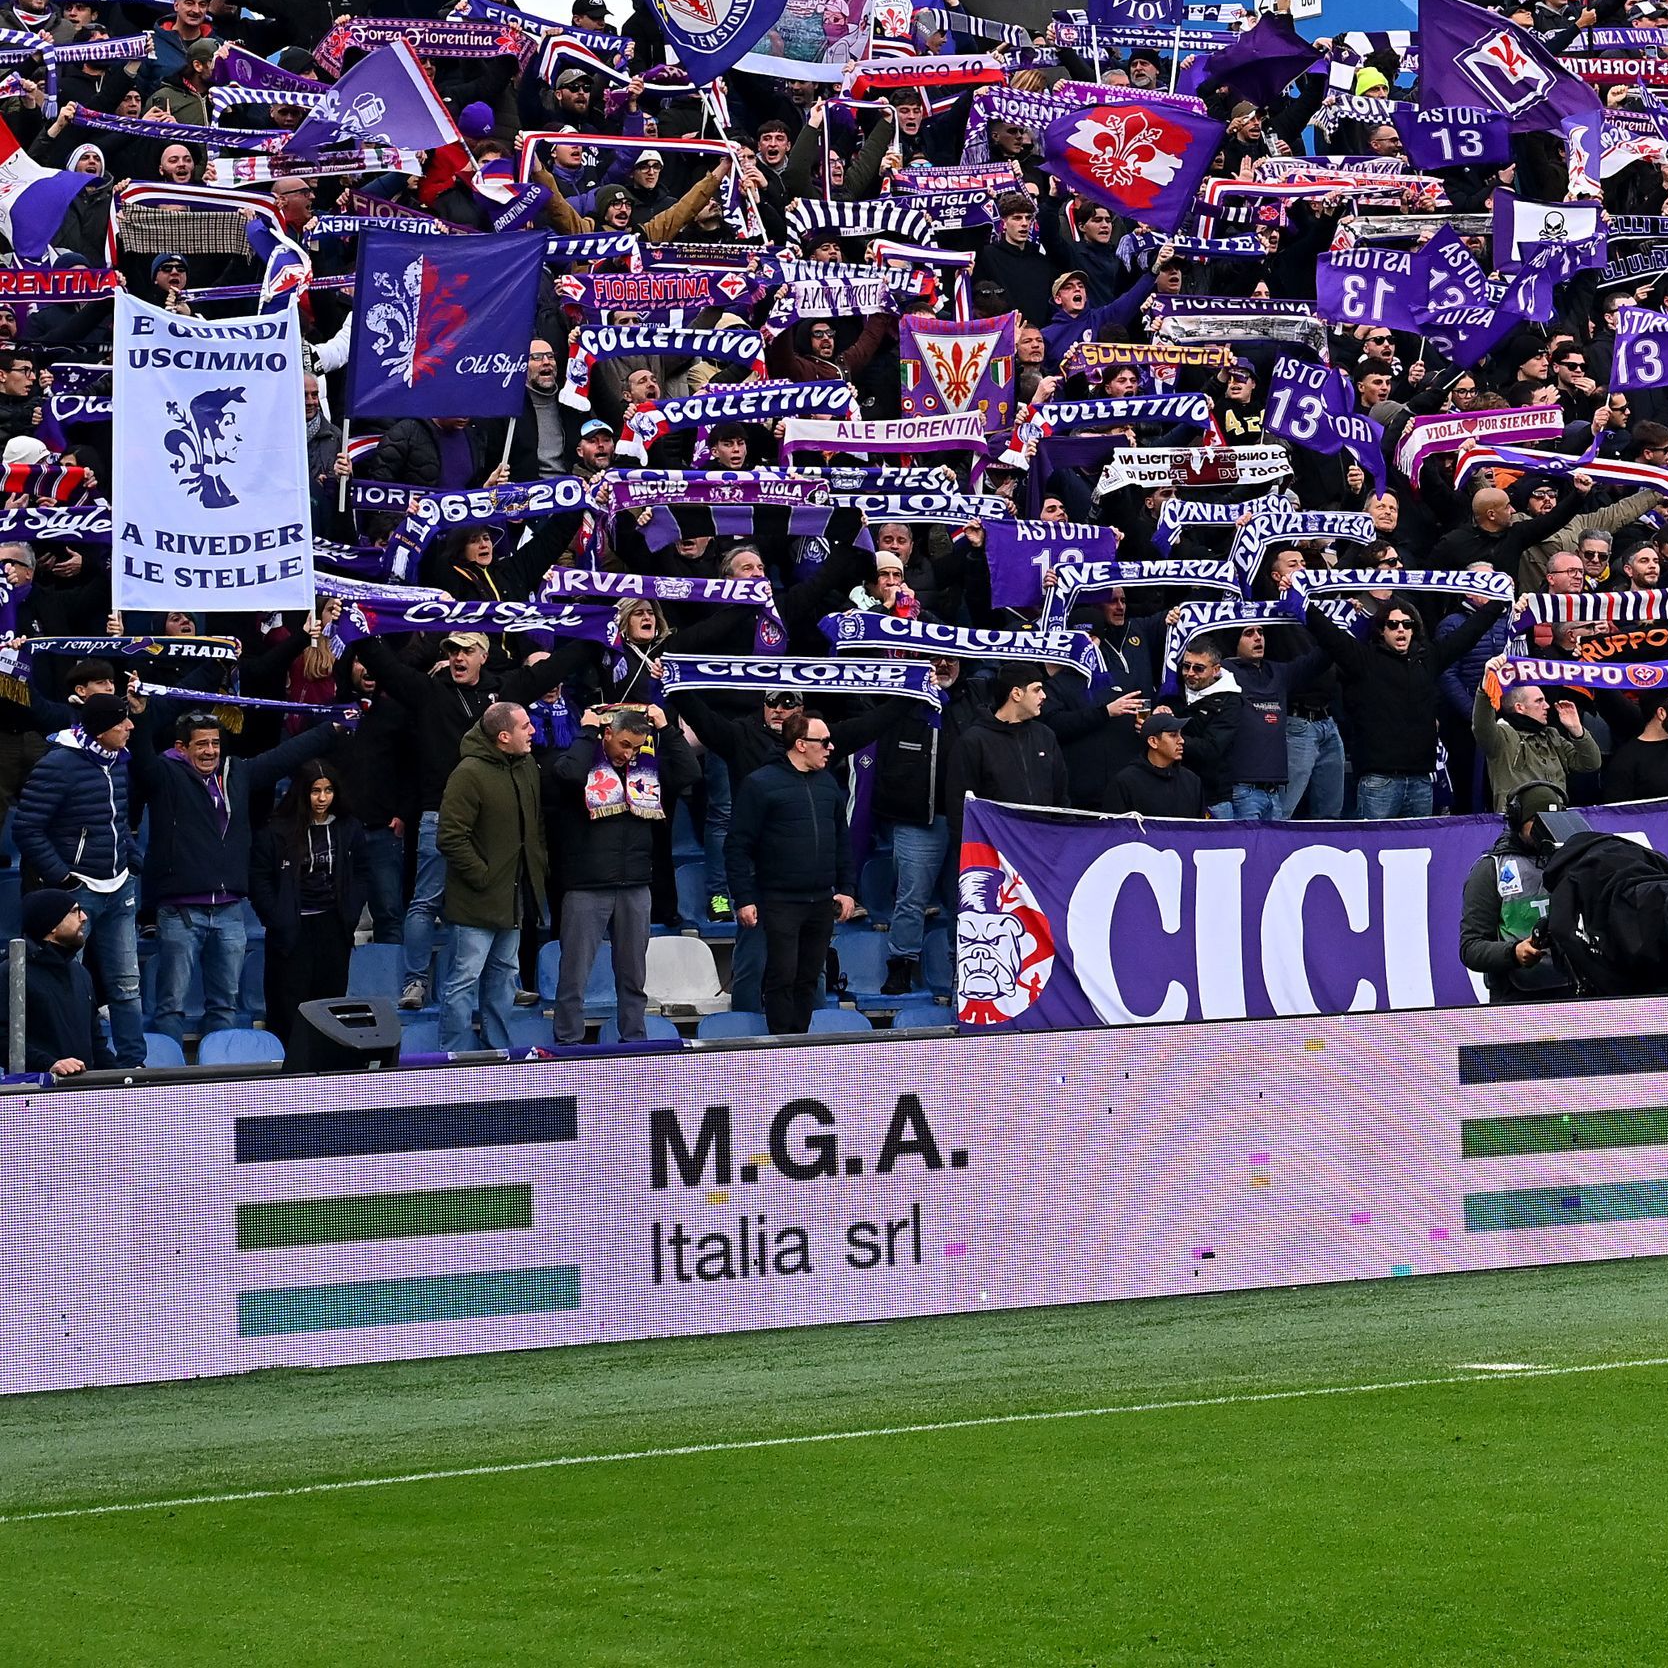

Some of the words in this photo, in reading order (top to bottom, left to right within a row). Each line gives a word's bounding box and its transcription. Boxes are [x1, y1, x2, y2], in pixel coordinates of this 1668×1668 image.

[352, 24, 404, 46] Forza
[415, 30, 493, 46] Fiorentina
[1432, 129, 1485, 157] 13
[592, 274, 710, 302] FIORENTINA
[131, 316, 154, 335] E
[167, 320, 288, 341] QUINDI
[128, 347, 288, 373] USCIMMO
[455, 354, 488, 375] Old
[664, 384, 852, 418] COLLETTIVO
[1271, 386, 1324, 440] 13
[1425, 423, 1464, 441] VIOLA
[1478, 418, 1499, 433] POR
[1500, 409, 1559, 431] SIEMPRE
[629, 481, 688, 498] INCUBO
[758, 483, 801, 498] VIOLA
[121, 522, 144, 545] A
[154, 522, 305, 556] RIVEDER
[123, 554, 166, 581] LE
[172, 555, 304, 589] STELLE
[404, 602, 489, 624] Old
[881, 617, 1076, 649] CICLONE
[699, 663, 907, 685] CICLONE
[1498, 659, 1622, 686] GRUPPO
[650, 1094, 970, 1188] M.G.A.
[652, 1217, 812, 1285] Italia
[846, 1204, 921, 1269] srl
